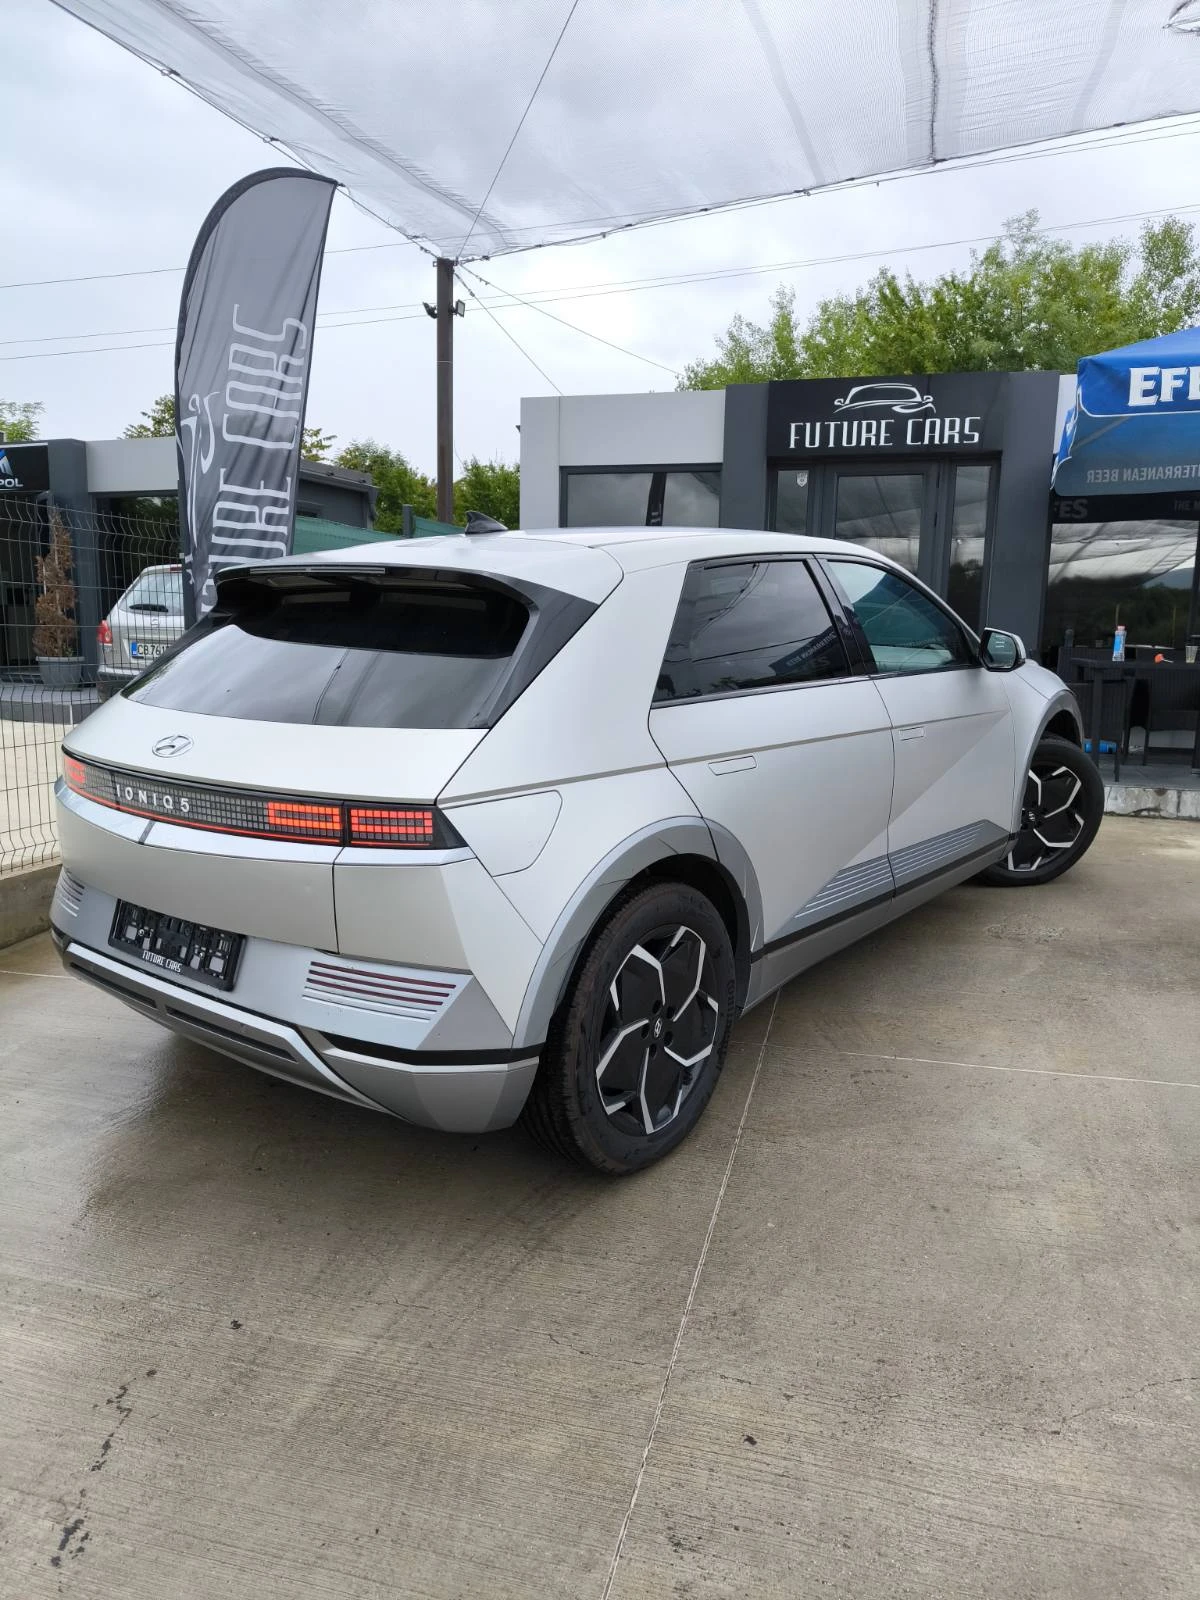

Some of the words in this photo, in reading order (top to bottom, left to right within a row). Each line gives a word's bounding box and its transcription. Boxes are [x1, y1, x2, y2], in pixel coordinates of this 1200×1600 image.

[222, 304, 308, 449] CARS
[789, 419, 895, 449] FUTURE
[906, 416, 981, 445] CARS
[116, 784, 173, 809] IONIQ
[180, 797, 190, 813] 5
[142, 950, 166, 967] FUTURE
[165, 958, 182, 973] CARS
